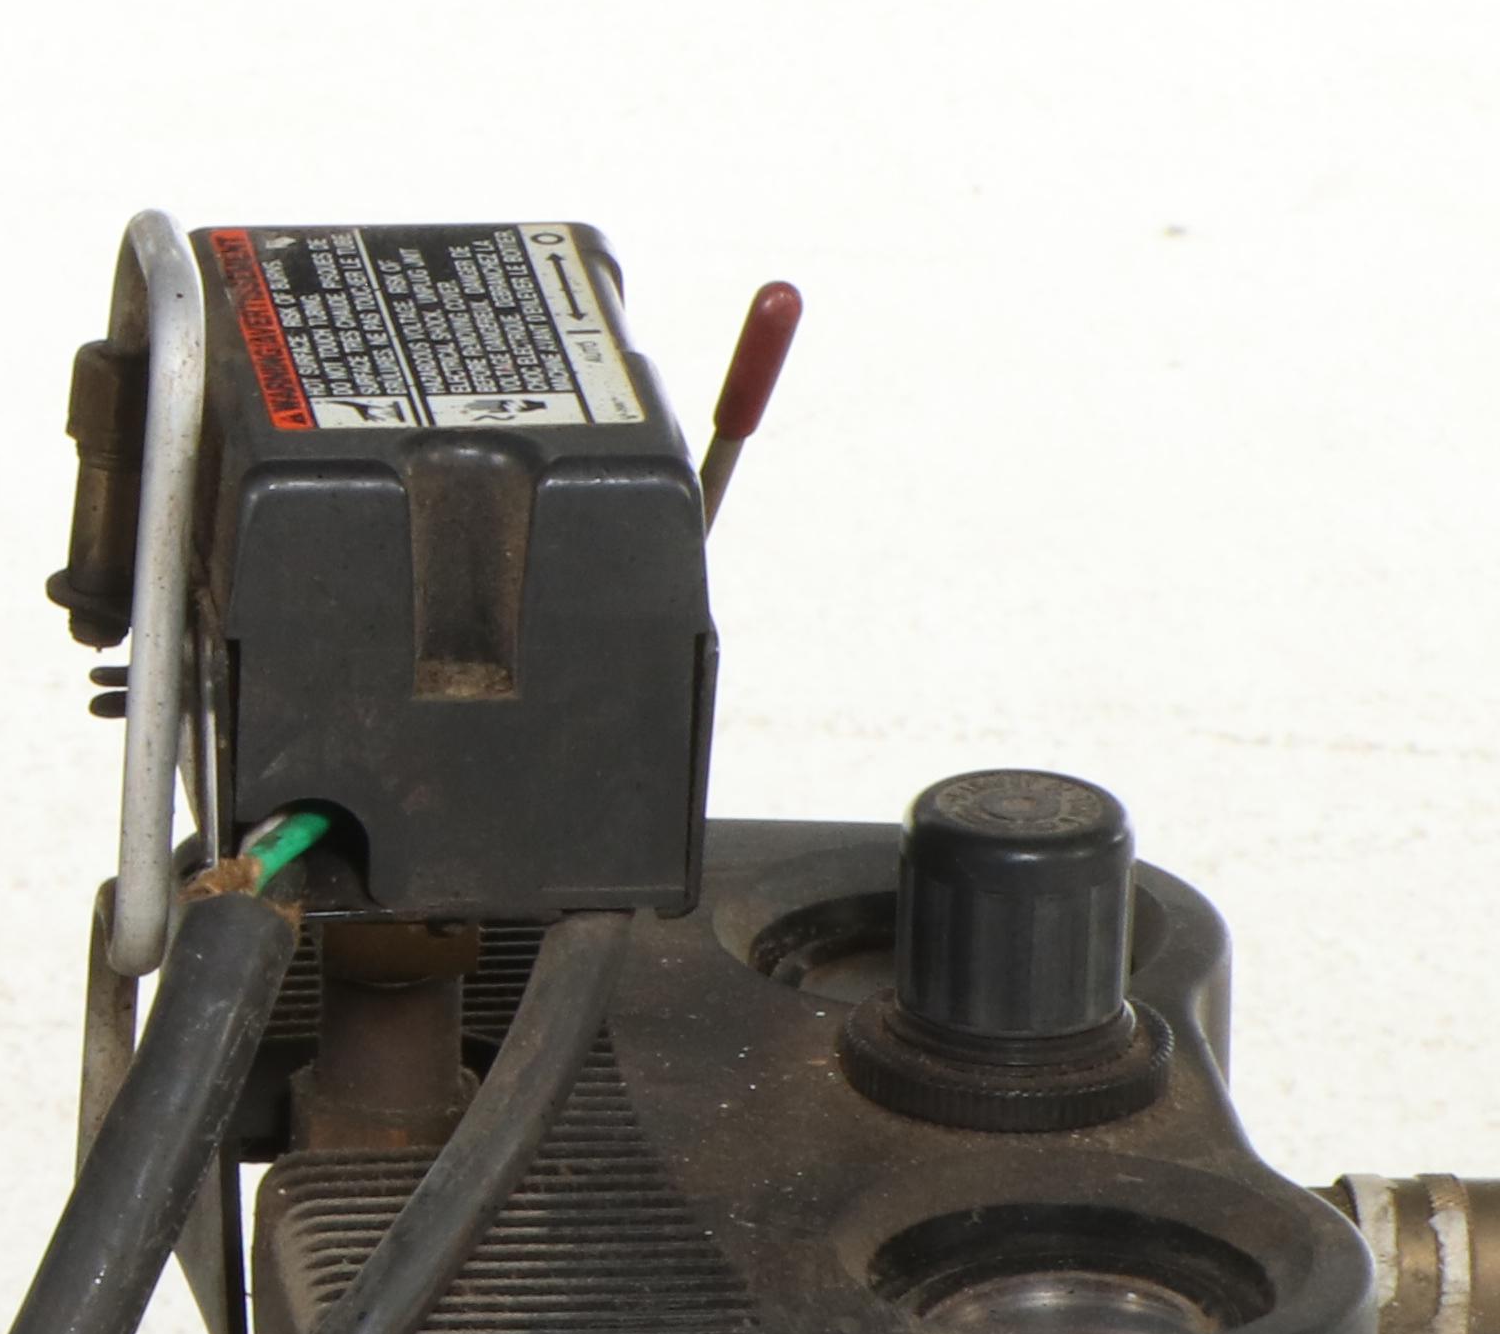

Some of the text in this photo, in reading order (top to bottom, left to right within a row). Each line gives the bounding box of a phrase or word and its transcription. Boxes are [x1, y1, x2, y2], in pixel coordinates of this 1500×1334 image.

[305, 237, 330, 250] DE
[447, 245, 473, 257] DE
[471, 239, 496, 251] LA
[338, 257, 362, 268] LE
[376, 258, 402, 272] OF
[504, 263, 529, 275] LE
[382, 274, 410, 293] RISK
[406, 268, 439, 303] UNPLUG
[452, 259, 486, 294] DANGER
[271, 291, 297, 304] OF
[276, 306, 304, 327] RISK
[358, 312, 384, 330] PAS
[310, 328, 341, 358] TOUCH
[364, 332, 389, 345] NE
[447, 312, 484, 356] REMOVING
[527, 323, 559, 351] AVANT
[322, 362, 349, 379] NOT
[346, 355, 381, 395] SURFACE
[407, 341, 447, 393] HAZARDOUS
[433, 342, 472, 393] ELECTRICAL
[464, 358, 498, 392] BEFORE
[487, 353, 523, 392] VOLTAGE
[538, 352, 574, 390] MACHINE
[301, 378, 328, 396] HOT
[329, 381, 355, 395] DO
[518, 366, 550, 391] CHOC
